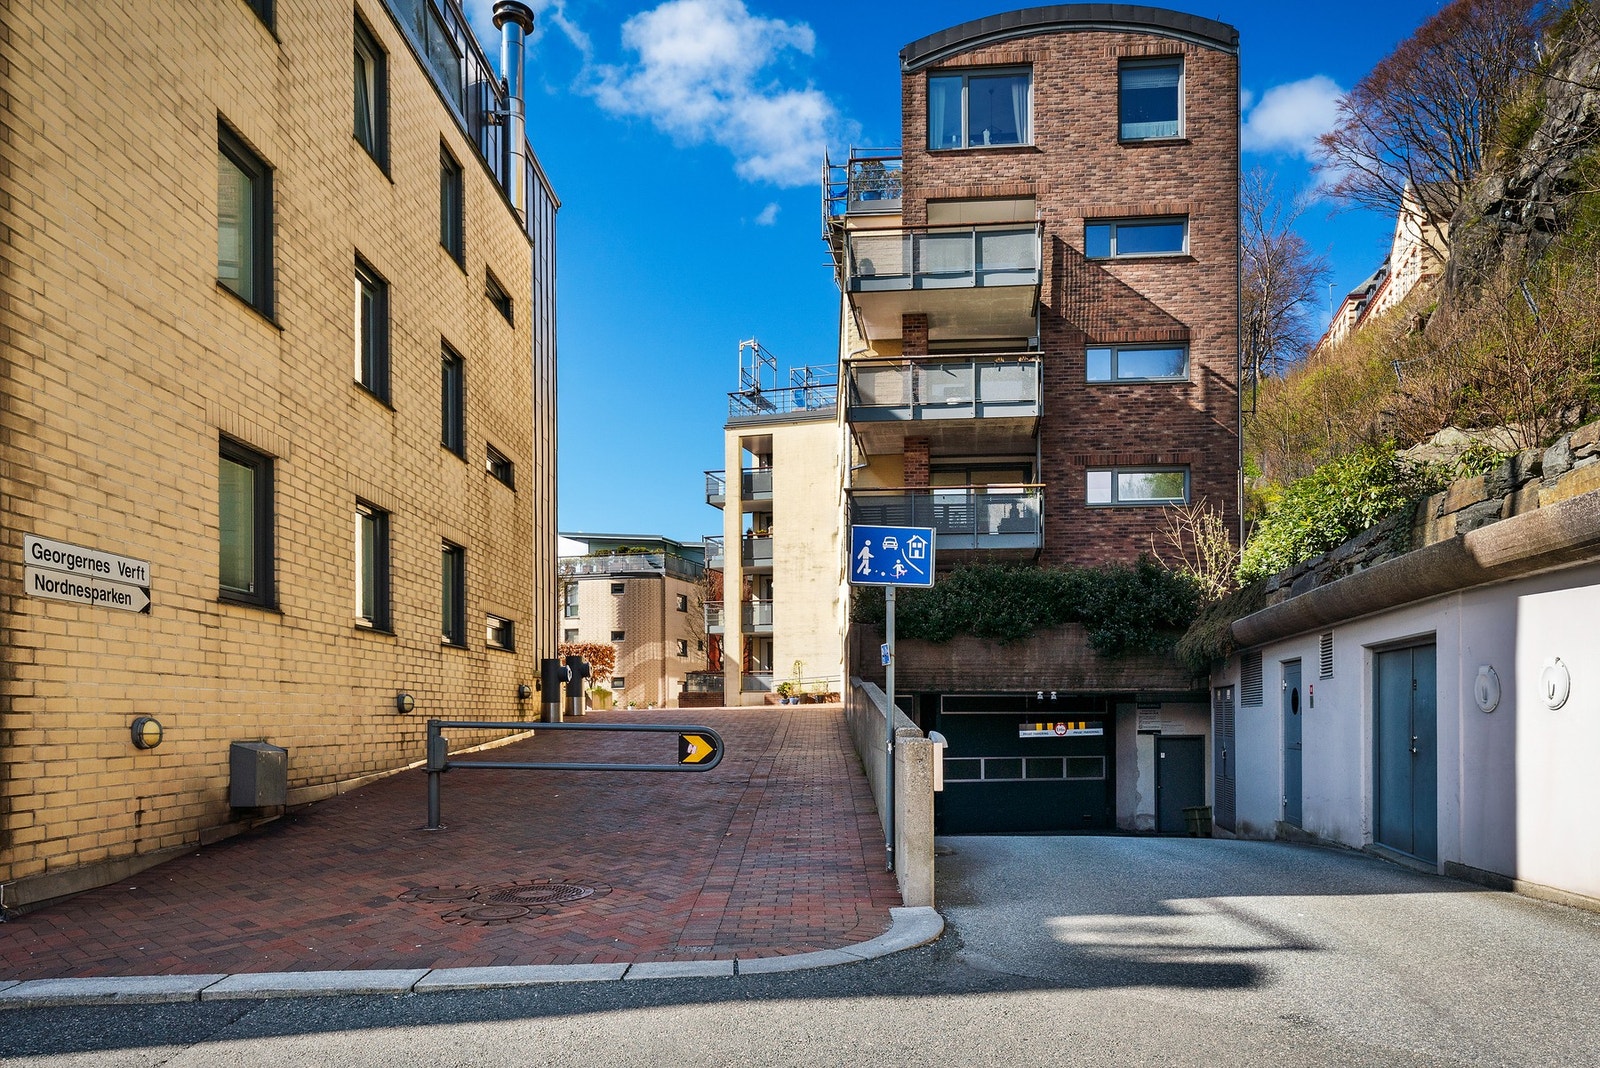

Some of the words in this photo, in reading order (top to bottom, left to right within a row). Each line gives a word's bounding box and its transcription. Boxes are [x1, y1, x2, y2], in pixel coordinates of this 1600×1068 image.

[31, 542, 111, 574] Georgernes
[117, 561, 145, 581] Verft
[34, 573, 132, 606] Nordnesparken
